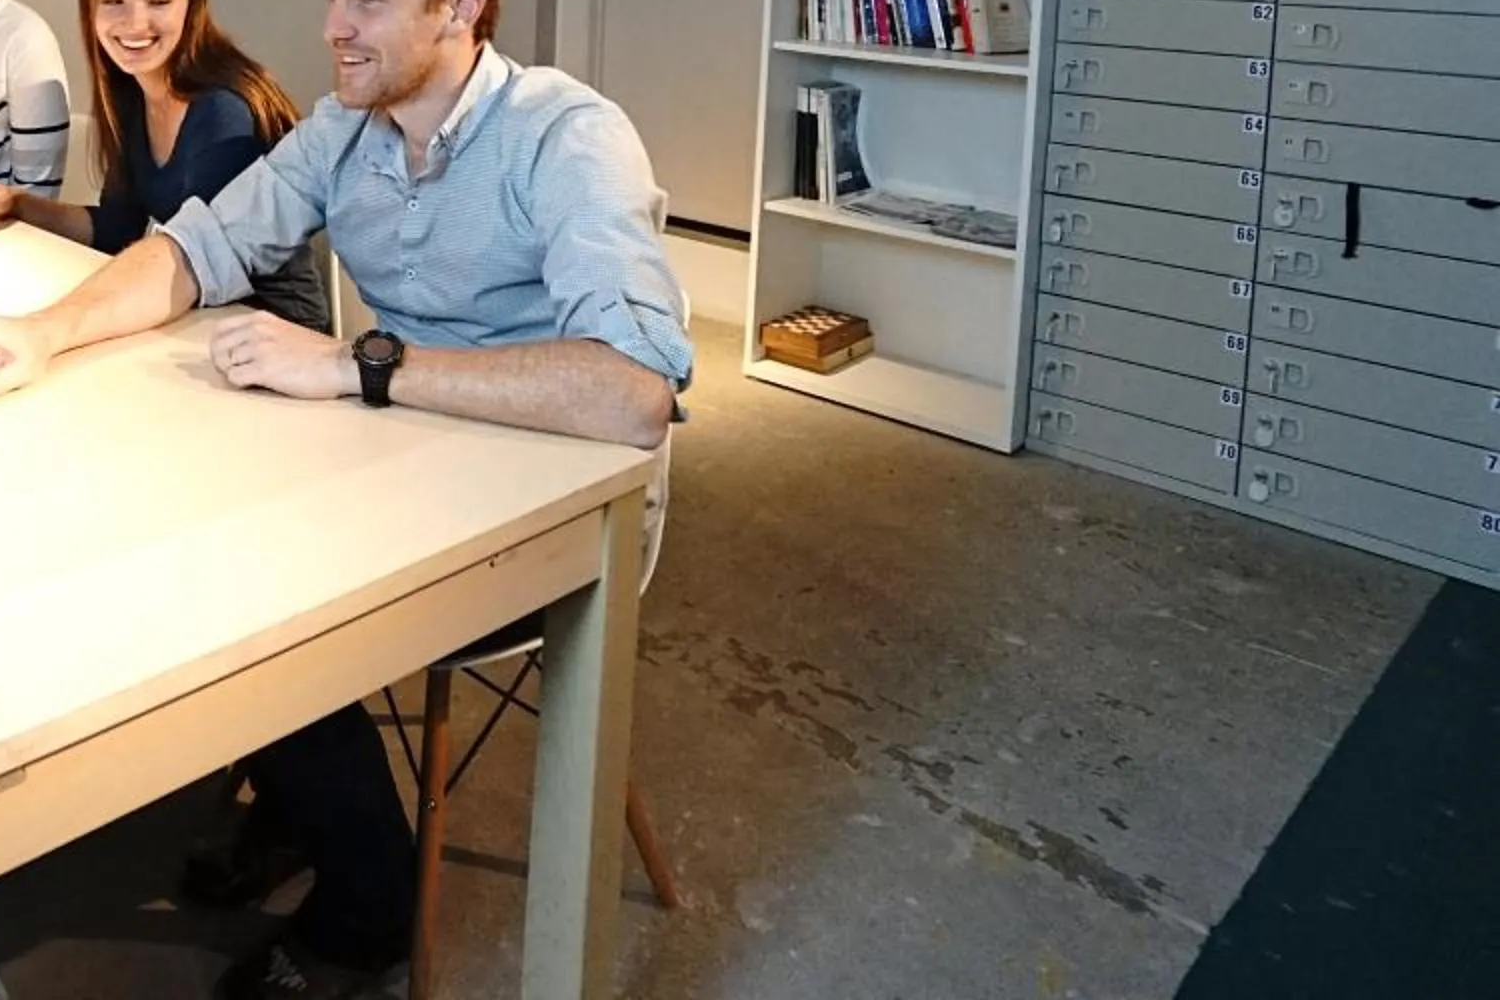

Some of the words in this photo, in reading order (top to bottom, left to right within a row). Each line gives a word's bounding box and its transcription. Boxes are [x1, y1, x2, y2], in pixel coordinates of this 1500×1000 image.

[1253, 5, 1272, 20] 62
[1249, 61, 1267, 76] 63
[1245, 117, 1263, 131] 64
[1241, 171, 1259, 186] 65
[1237, 227, 1255, 242] 66
[1233, 281, 1250, 296] 67
[1227, 335, 1245, 351] 68
[1223, 389, 1239, 405] 69
[1220, 443, 1236, 459] 70
[1489, 455, 1498, 470] 7
